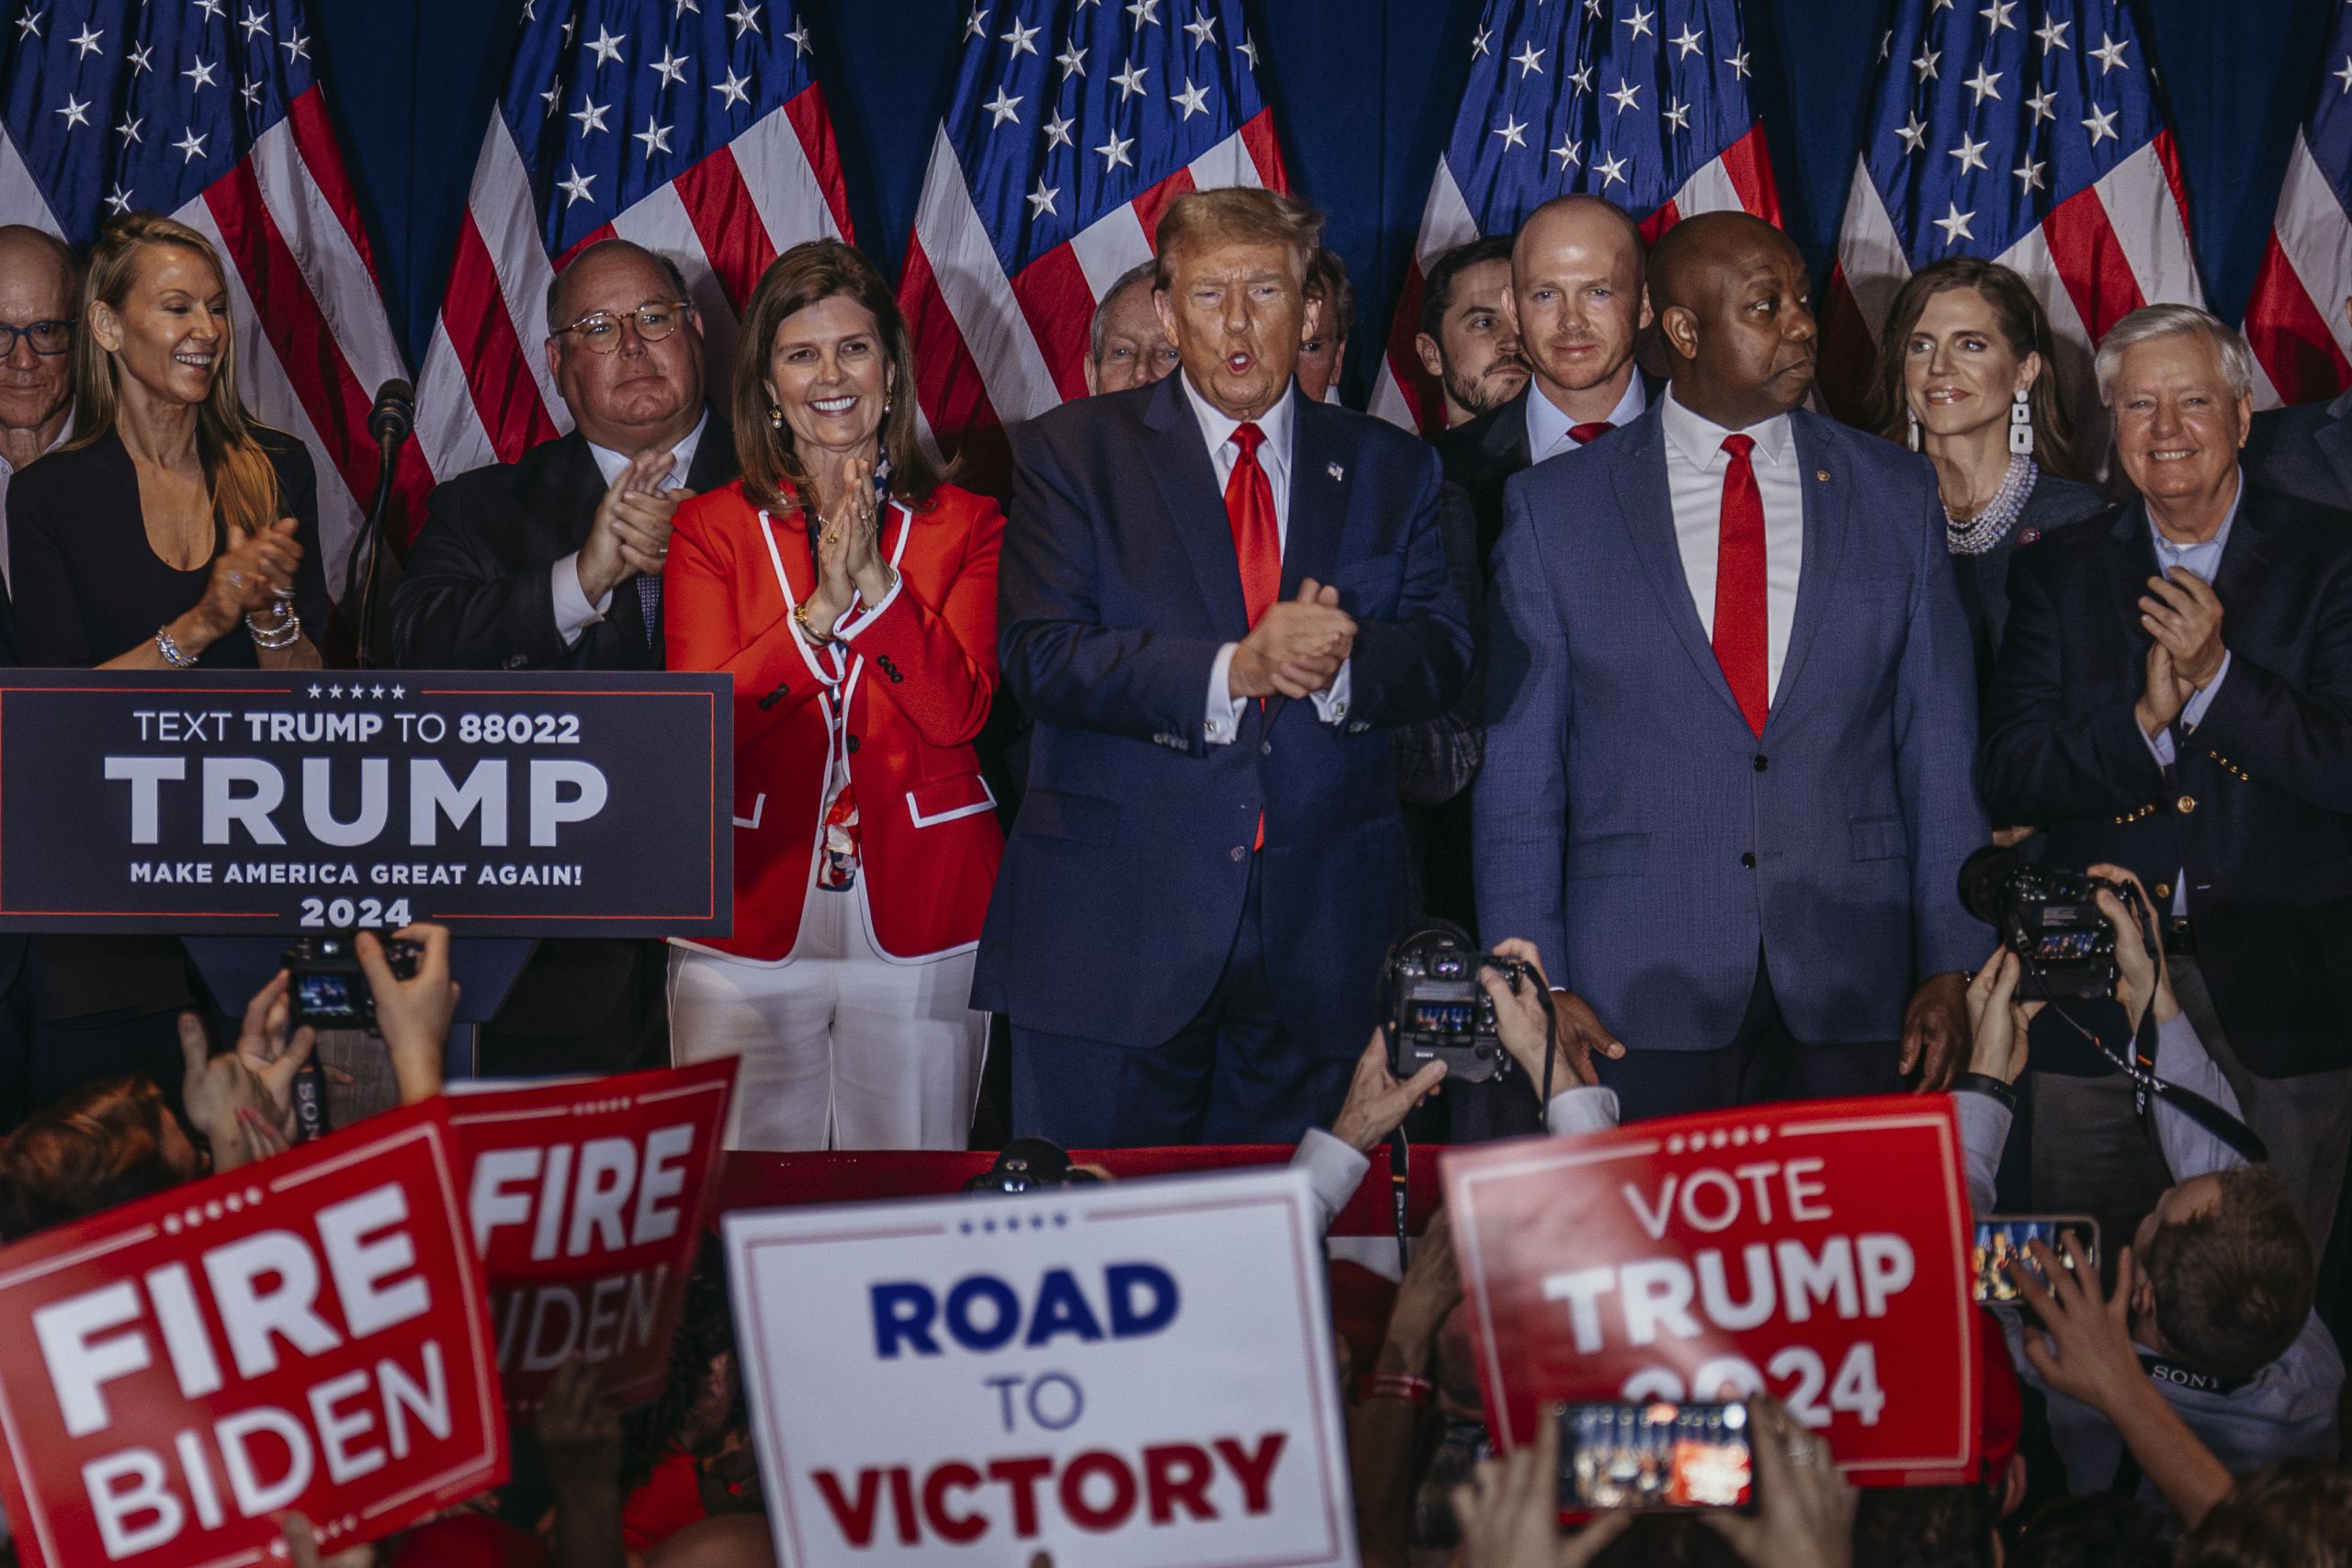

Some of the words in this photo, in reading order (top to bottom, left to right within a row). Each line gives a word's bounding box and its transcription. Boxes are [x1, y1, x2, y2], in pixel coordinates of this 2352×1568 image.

[132, 711, 232, 742] TEXT
[243, 712, 383, 743] TRUMP
[393, 713, 447, 744] TO
[458, 714, 581, 744] 88022
[104, 756, 608, 847] TRUMP
[130, 863, 213, 884] MAKE
[223, 863, 359, 885] AMERICA
[370, 864, 467, 885] GREAT
[477, 864, 582, 886] AGAIN!
[300, 897, 413, 928] 2024
[297, 1083, 322, 1141] SON
[469, 1123, 694, 1261] FIRE
[1623, 1156, 1833, 1240] VOTE
[31, 1182, 431, 1438] FIRE
[497, 1262, 668, 1371] IDEN
[867, 1261, 1182, 1359] ROAD
[1543, 1232, 1916, 1355] TRUMP
[983, 1371, 1085, 1433] TO
[82, 1340, 452, 1561] BIDEN
[809, 1430, 1289, 1551] VICTORY
